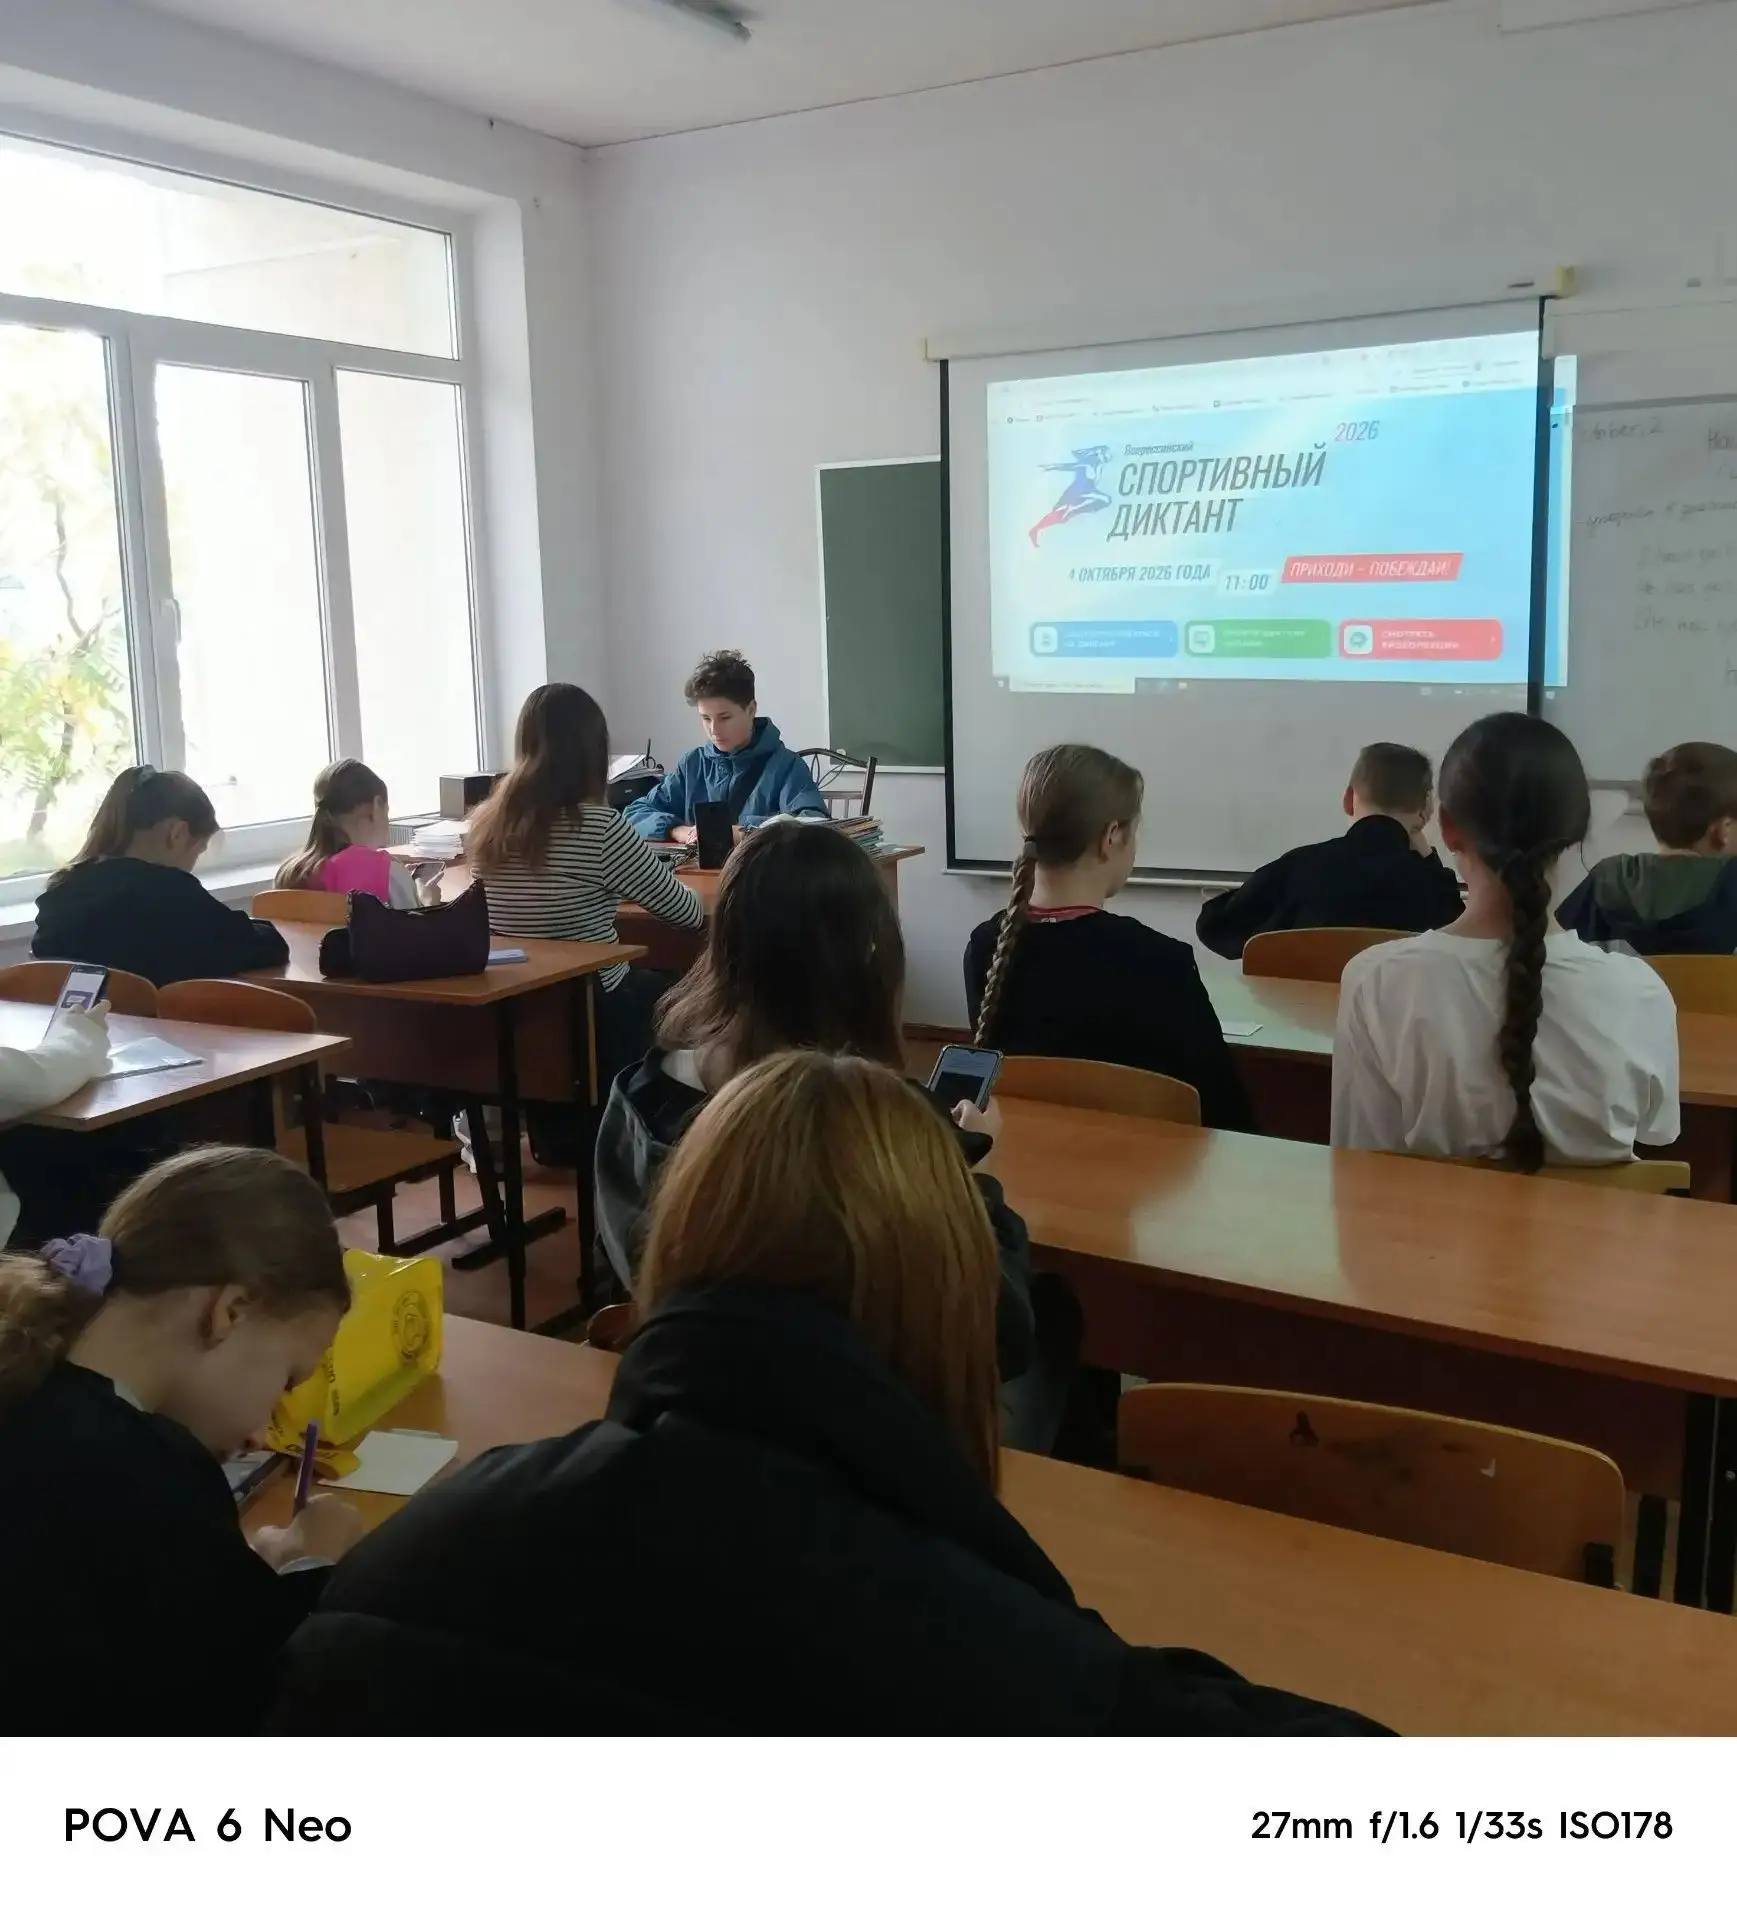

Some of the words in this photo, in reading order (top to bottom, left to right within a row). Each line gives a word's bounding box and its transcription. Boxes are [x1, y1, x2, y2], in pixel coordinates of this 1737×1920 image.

[1334, 420, 1380, 442] 2026
[1118, 442, 1327, 496] СПОРТИВНЫЙ
[1107, 498, 1244, 542] ДИКТАНТ
[1078, 566, 1136, 582] ОКТЯБРЯ
[1139, 565, 1172, 581] 2026
[1176, 564, 1211, 582] ГОДА
[1290, 560, 1354, 578] ПРИХОДИ
[1225, 573, 1270, 591] 11:00
